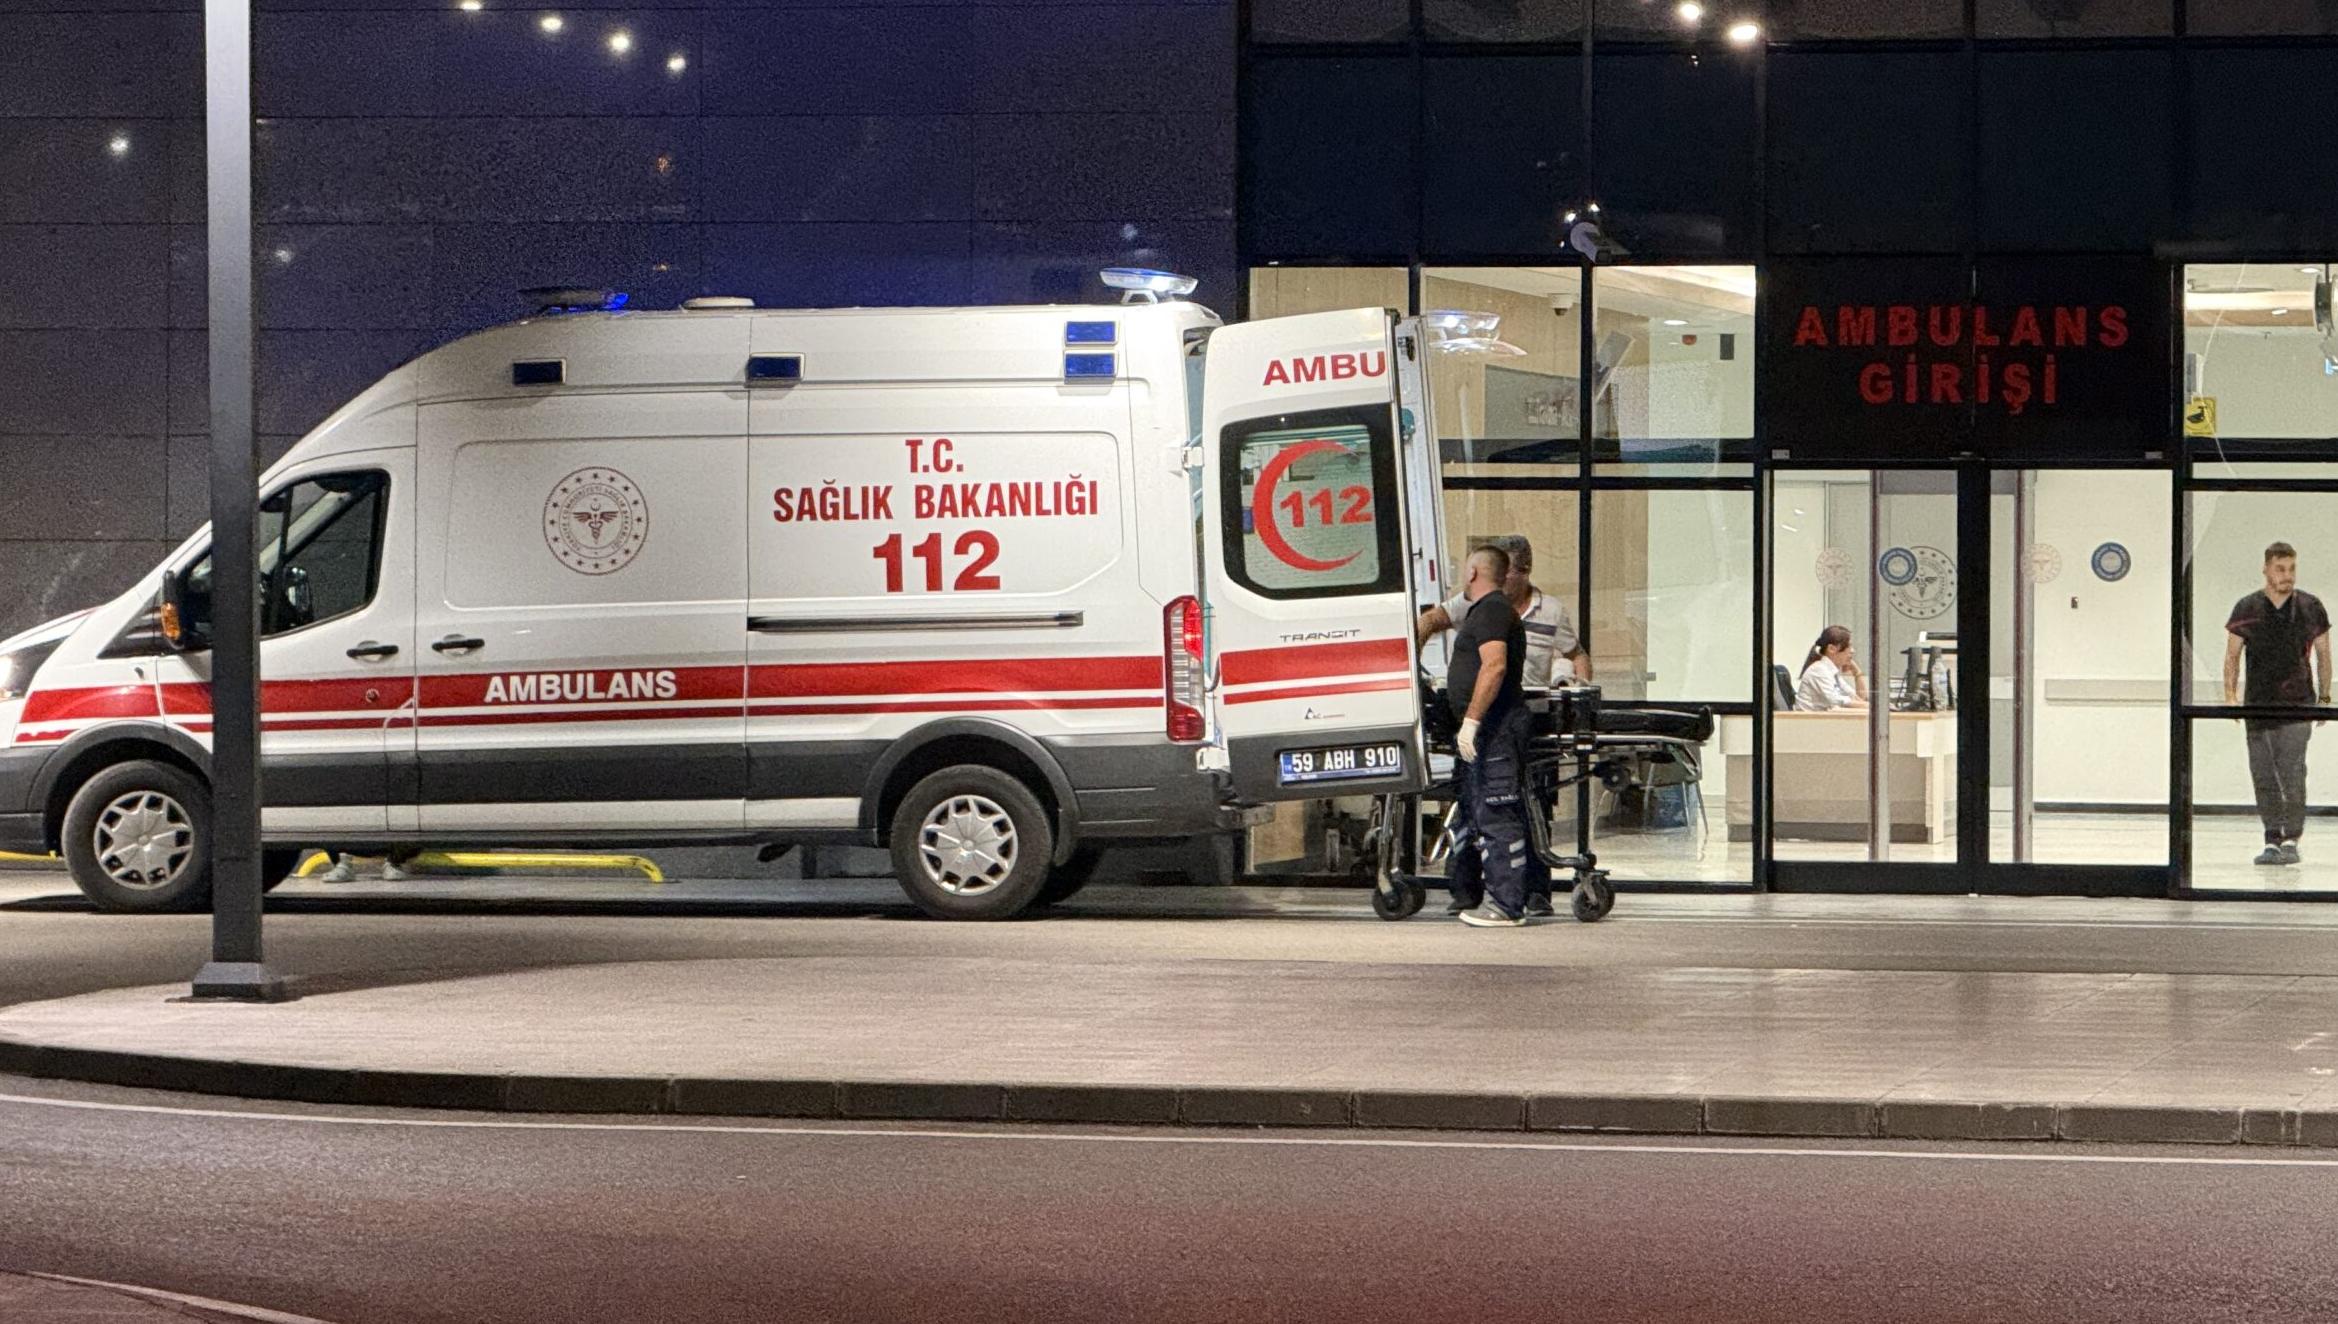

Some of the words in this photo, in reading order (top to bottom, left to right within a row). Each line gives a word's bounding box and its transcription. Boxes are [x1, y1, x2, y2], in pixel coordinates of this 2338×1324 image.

[1793, 306, 2128, 346] AMBULANS
[1263, 351, 1386, 386] AMBU
[1858, 354, 2056, 415] GİRİŞİ
[905, 438, 964, 473] T.C.
[773, 478, 894, 522] SAĞLIK
[914, 473, 1098, 519] BAKANLIĞI
[1280, 485, 1374, 528] 112
[872, 530, 1001, 593] 112
[1279, 629, 1361, 643] TRANSIT
[484, 670, 677, 703] AMBULANS
[1291, 752, 1314, 773] 59
[1323, 749, 1355, 771] ABH
[1364, 746, 1397, 767] 910
